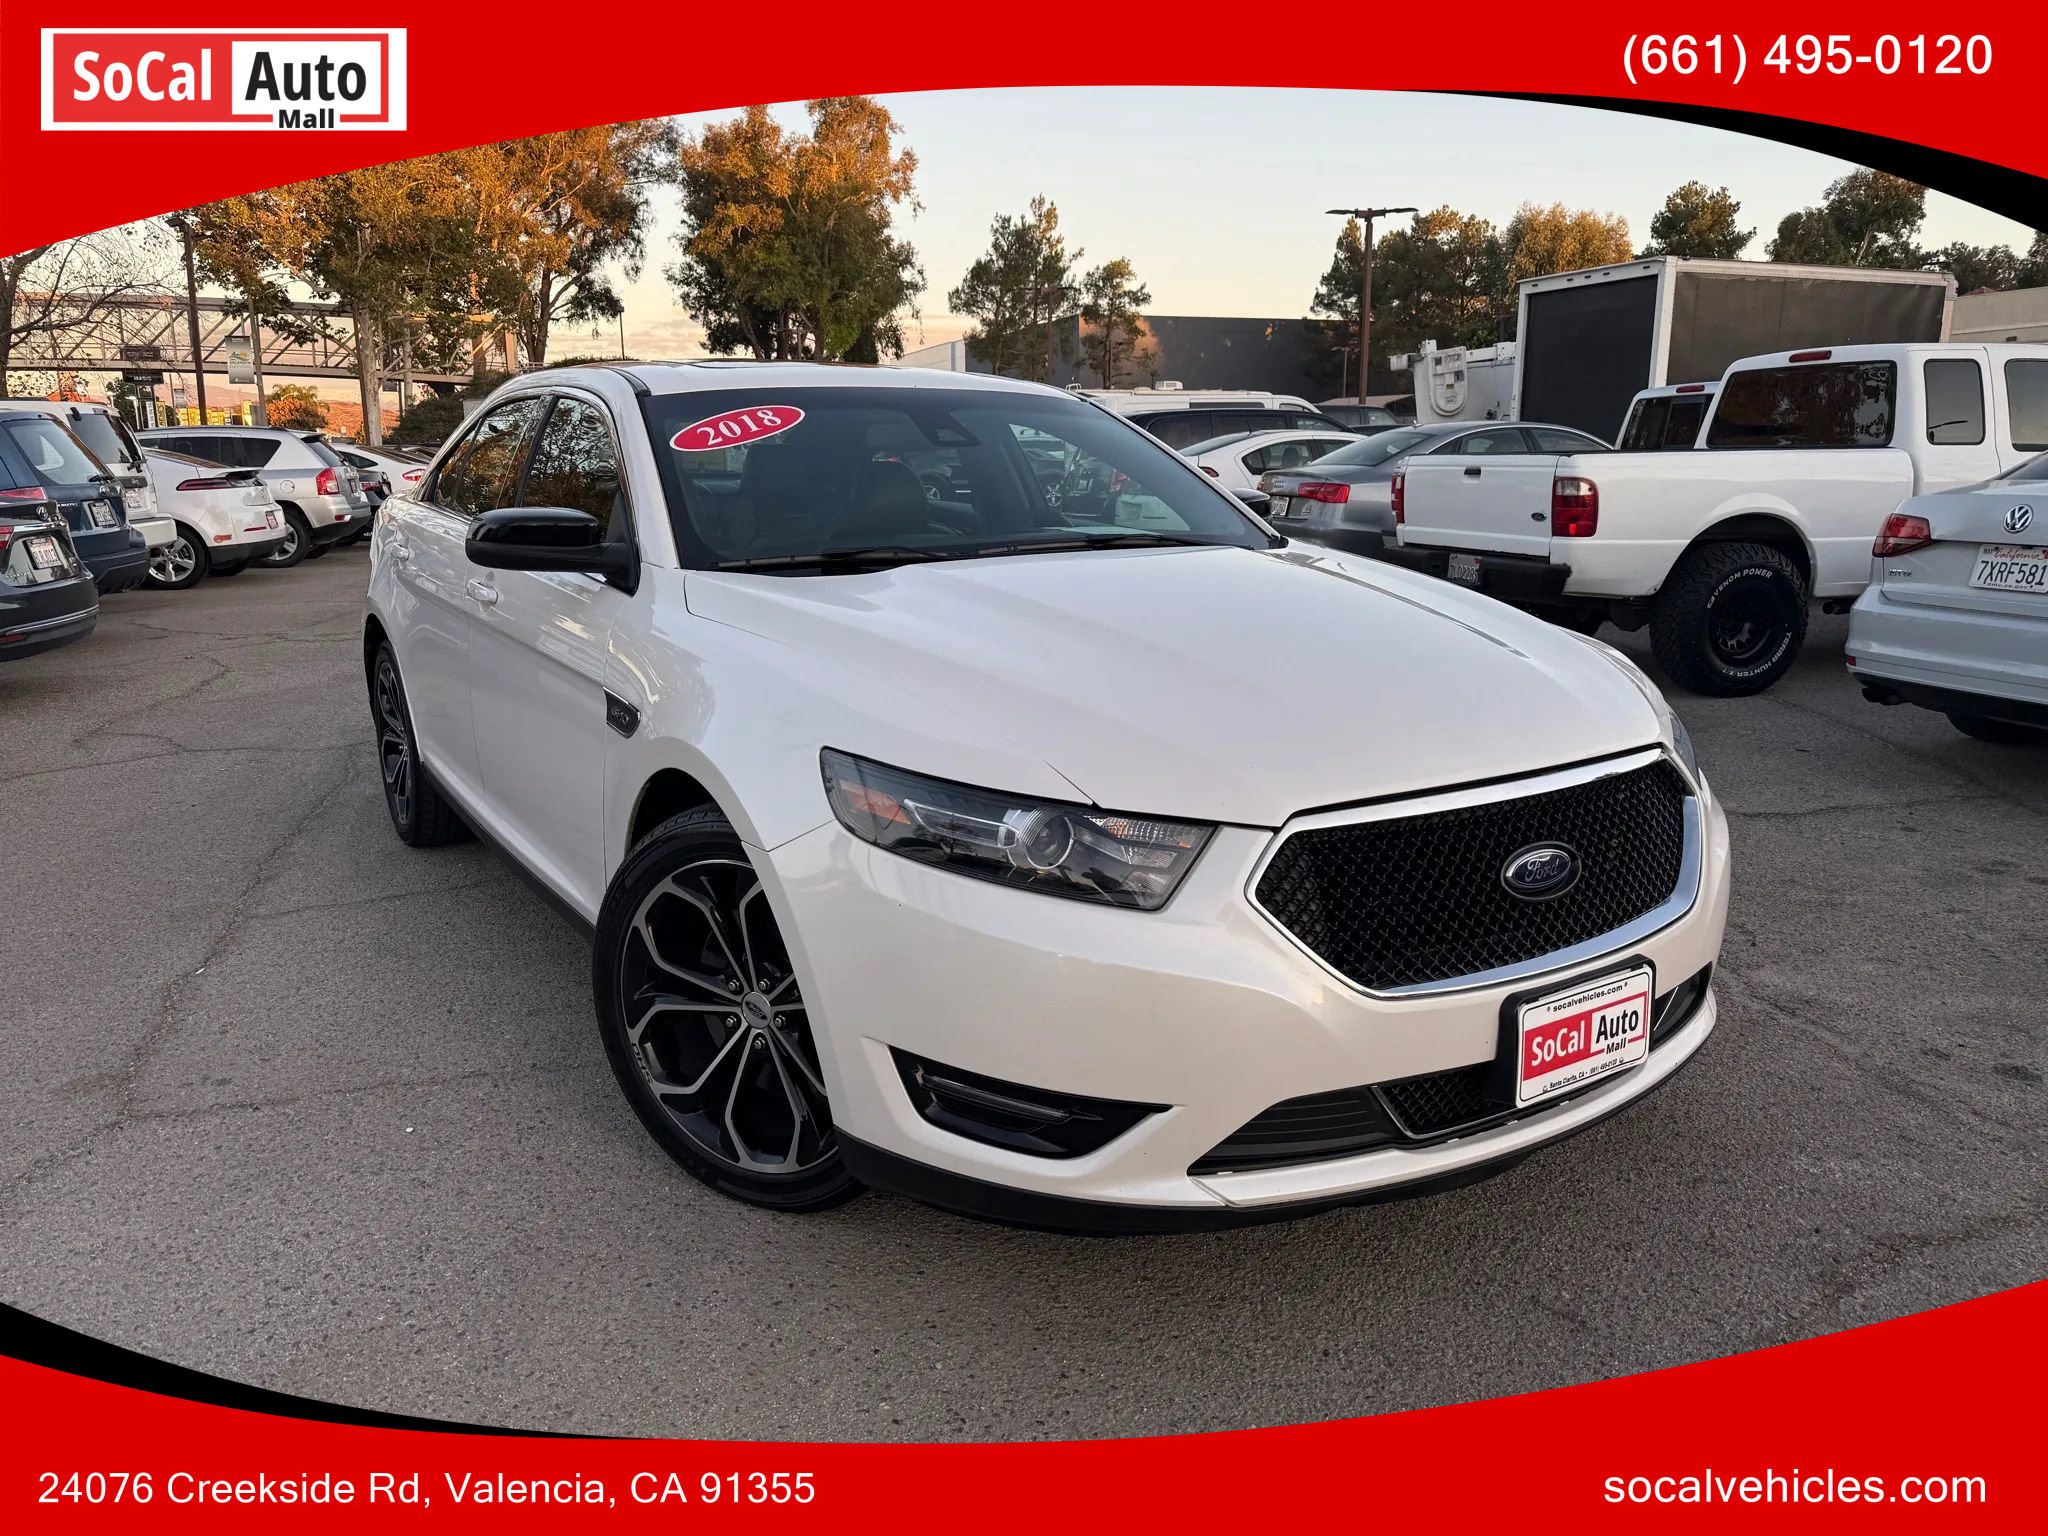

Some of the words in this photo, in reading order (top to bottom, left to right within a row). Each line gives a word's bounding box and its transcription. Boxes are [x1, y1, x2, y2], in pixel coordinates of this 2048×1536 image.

[696, 409, 782, 446] 2018
[1995, 547, 2044, 562] California
[1714, 571, 1741, 596] VENOM
[1742, 567, 1773, 579] POWER
[1977, 560, 2048, 587] 7XRF581
[1736, 660, 1772, 677] HUNTER
[1524, 854, 1561, 882] Ford
[1552, 985, 1623, 1012] socalvehicles.com
[1531, 1019, 1585, 1067] SoCal
[1595, 1008, 1639, 1044] Auto
[1606, 1037, 1627, 1055] Mall
